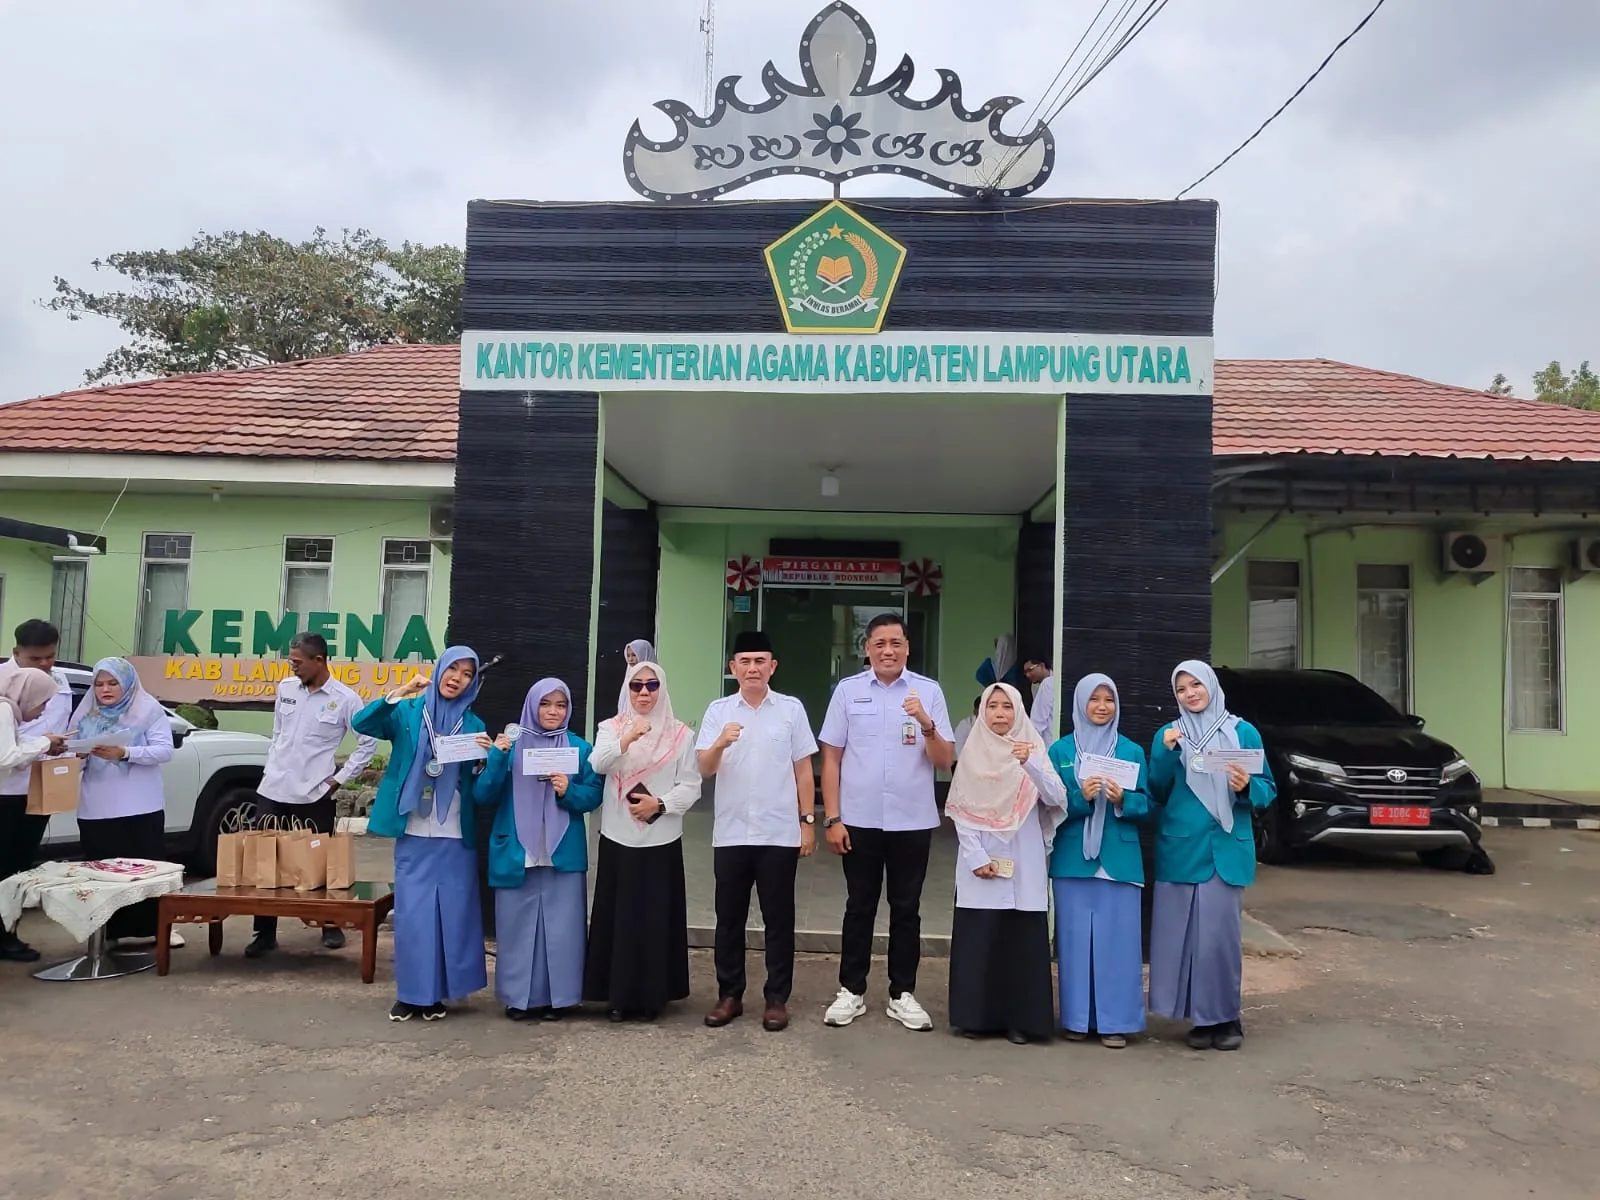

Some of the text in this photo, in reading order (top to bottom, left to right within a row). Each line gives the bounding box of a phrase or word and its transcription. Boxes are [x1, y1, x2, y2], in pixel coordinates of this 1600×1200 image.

[476, 342, 1192, 384] KANTOR KEMENTERIAN AGAMA KABUPATEN LAMPUNG UTARA
[781, 560, 880, 571] DIRGAHAYU
[162, 609, 450, 660] KEMENA
[165, 658, 222, 680] KAB
[232, 660, 360, 685] LAMNG
